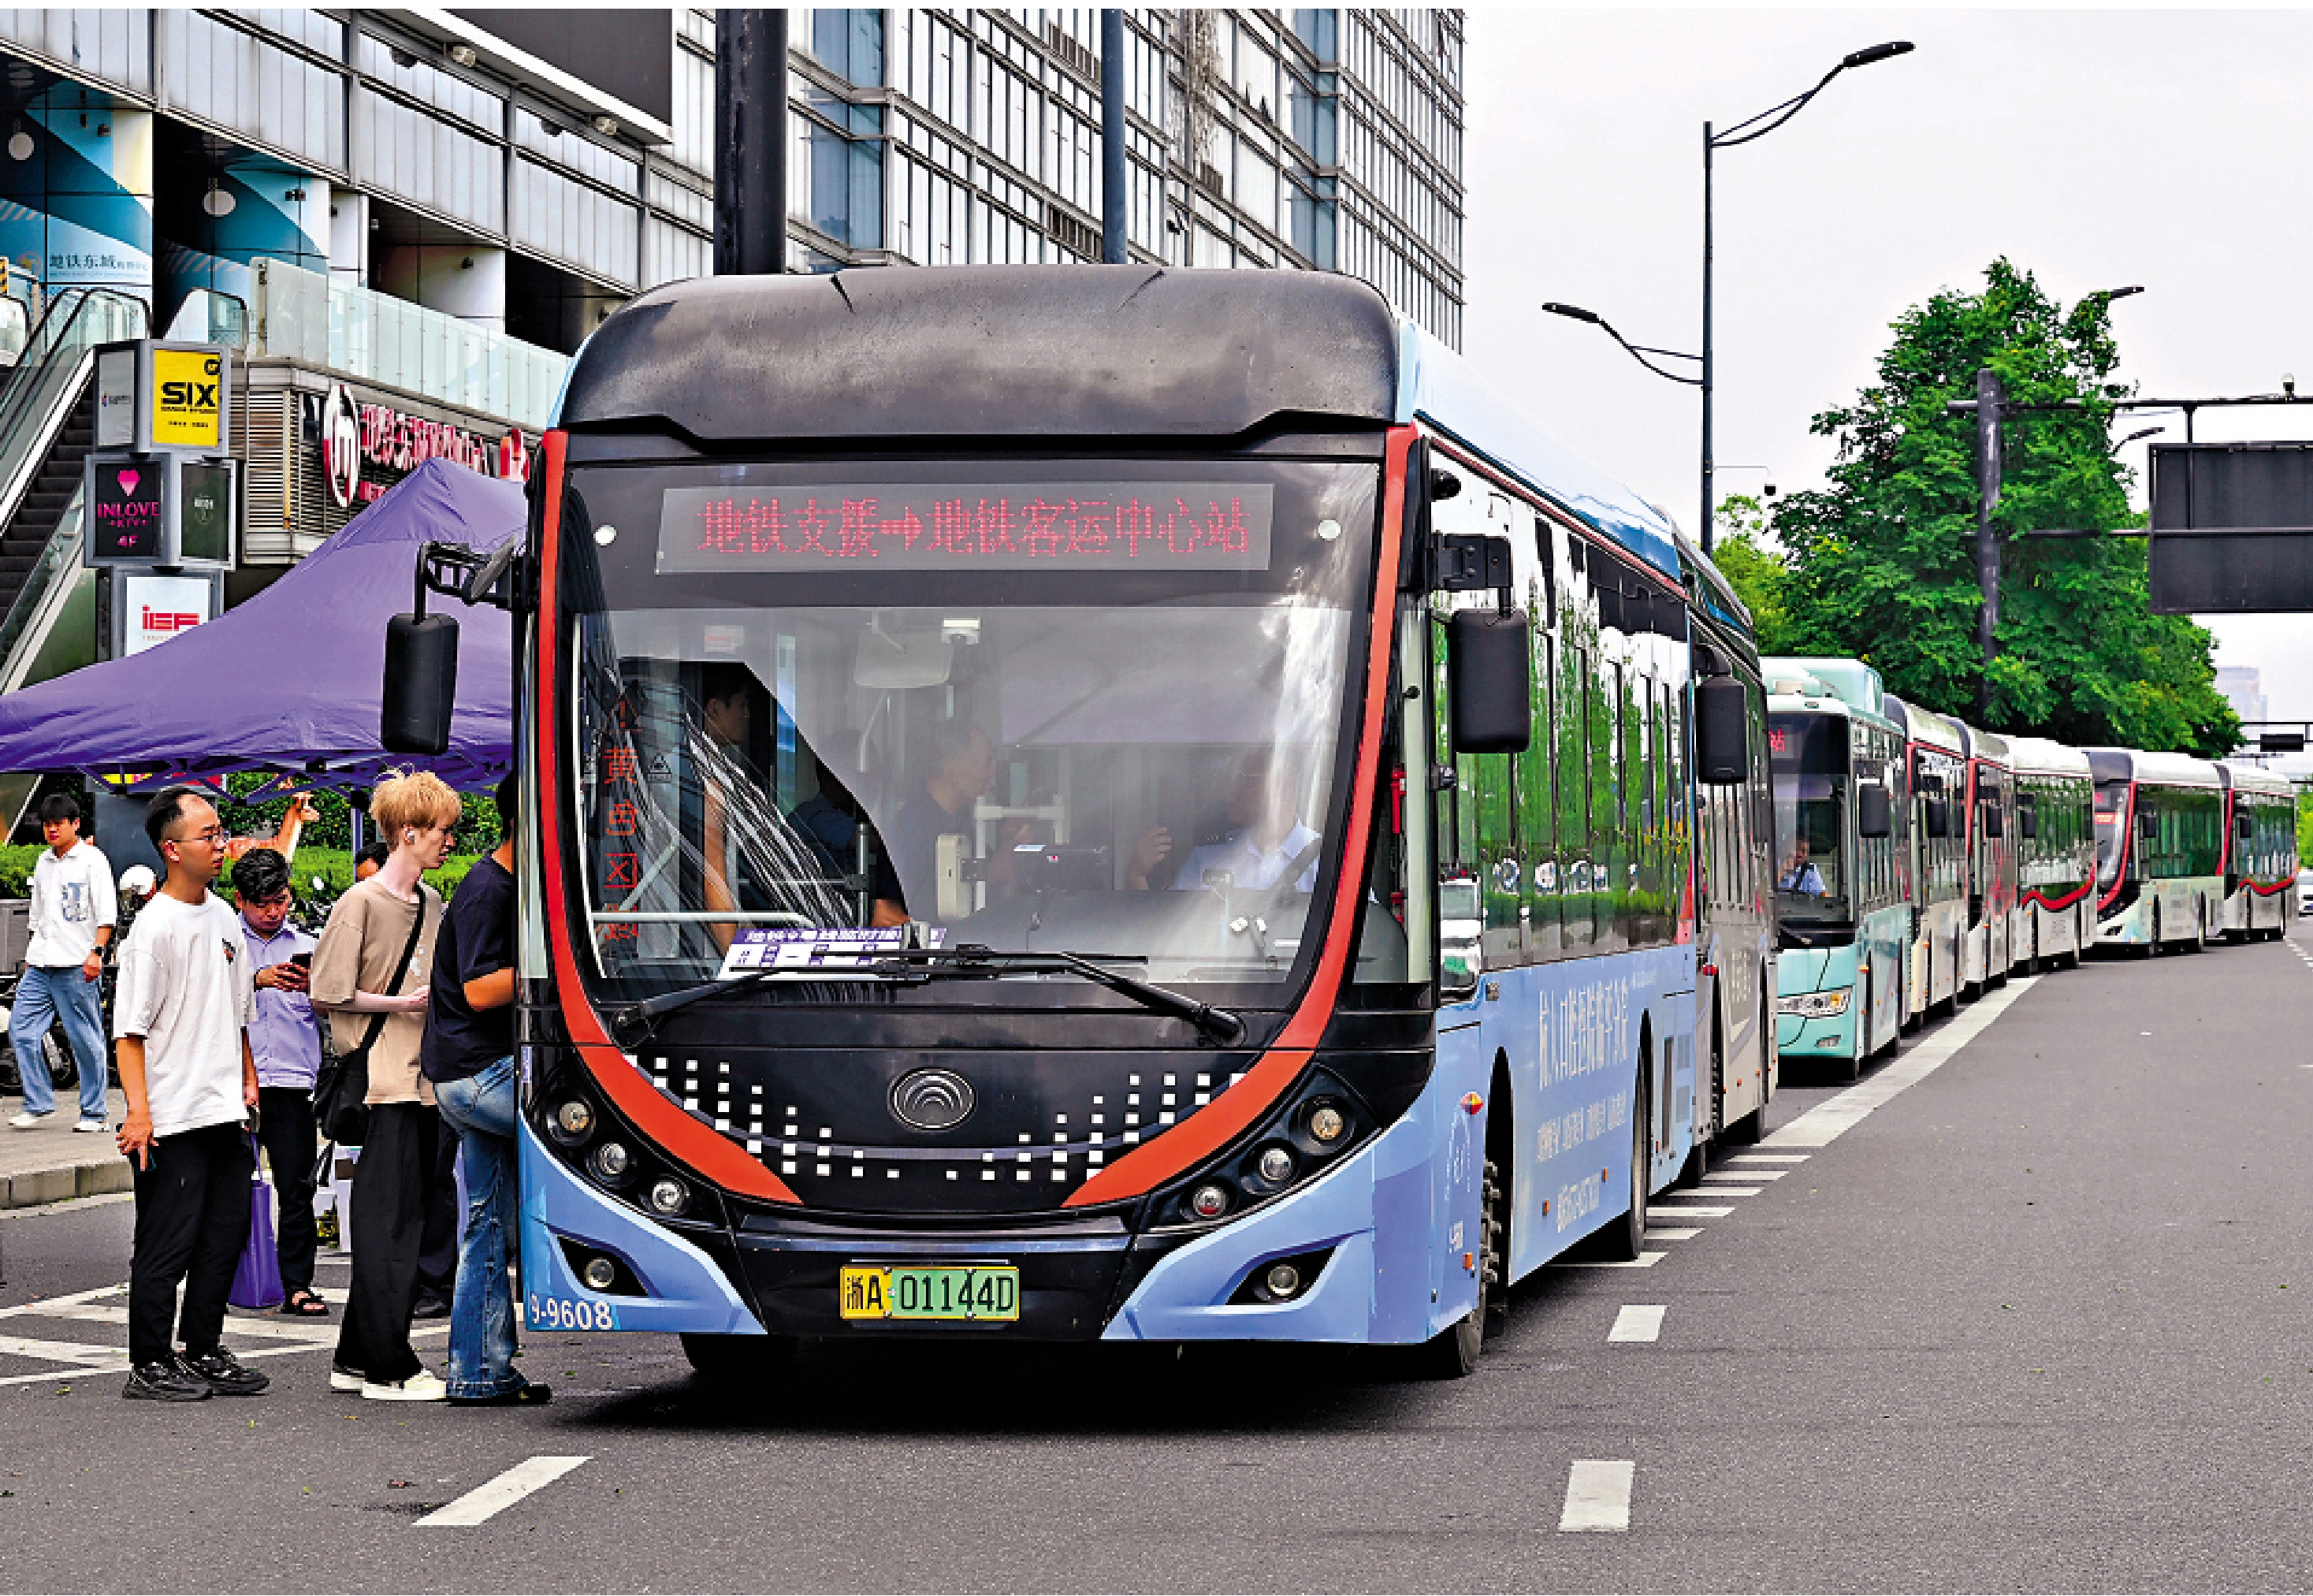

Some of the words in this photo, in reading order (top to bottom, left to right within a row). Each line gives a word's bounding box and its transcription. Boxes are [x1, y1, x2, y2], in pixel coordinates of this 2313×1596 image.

[161, 382, 216, 407] SIX
[97, 501, 160, 516] INLOVE
[926, 497, 1251, 556] 地铁客运中心站
[117, 535, 139, 548] 4F
[900, 1274, 1015, 1311] 01144D
